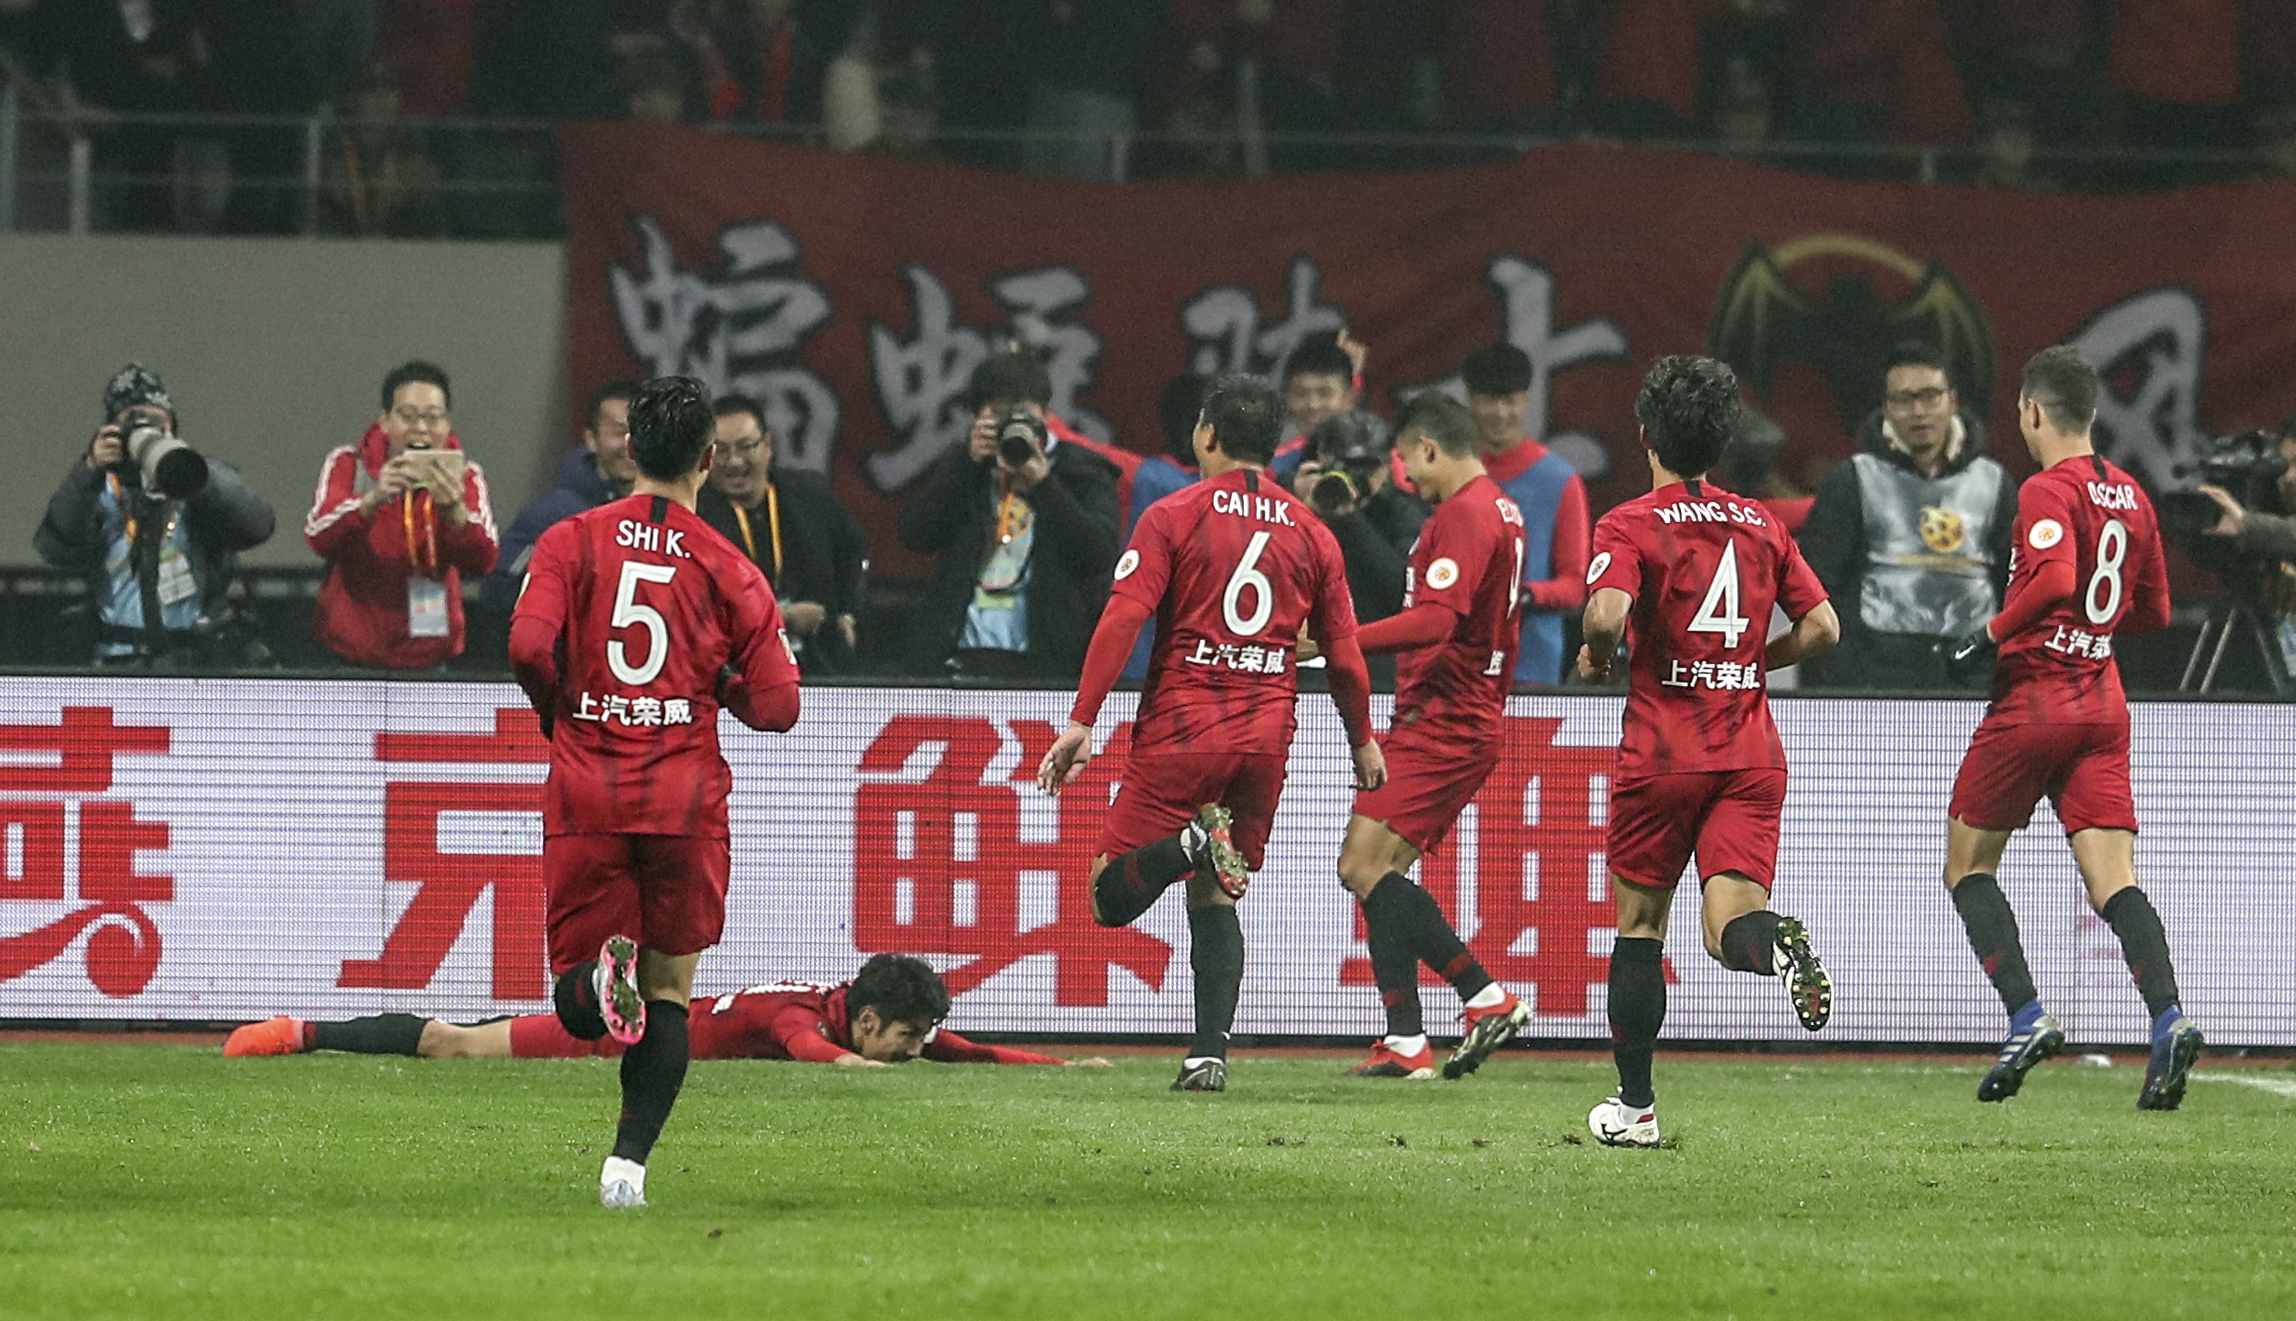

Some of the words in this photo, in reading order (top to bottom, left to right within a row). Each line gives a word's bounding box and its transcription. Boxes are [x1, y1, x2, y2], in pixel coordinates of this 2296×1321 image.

[1213, 490, 1249, 517] CAI
[1255, 496, 1296, 527] H.K.
[1653, 501, 1728, 524] WANG
[1731, 501, 1767, 527] S.C.
[2087, 481, 2138, 510] OSCAR
[616, 519, 659, 551] SHI
[665, 529, 692, 558] K.
[1223, 530, 1273, 636] 6
[2085, 519, 2127, 624] 8
[1687, 538, 1749, 648] 4
[607, 560, 677, 686] 5
[1185, 639, 1286, 674] 上汽荣威
[2044, 624, 2113, 660] 上汽荣
[572, 692, 693, 726] 上汽荣威
